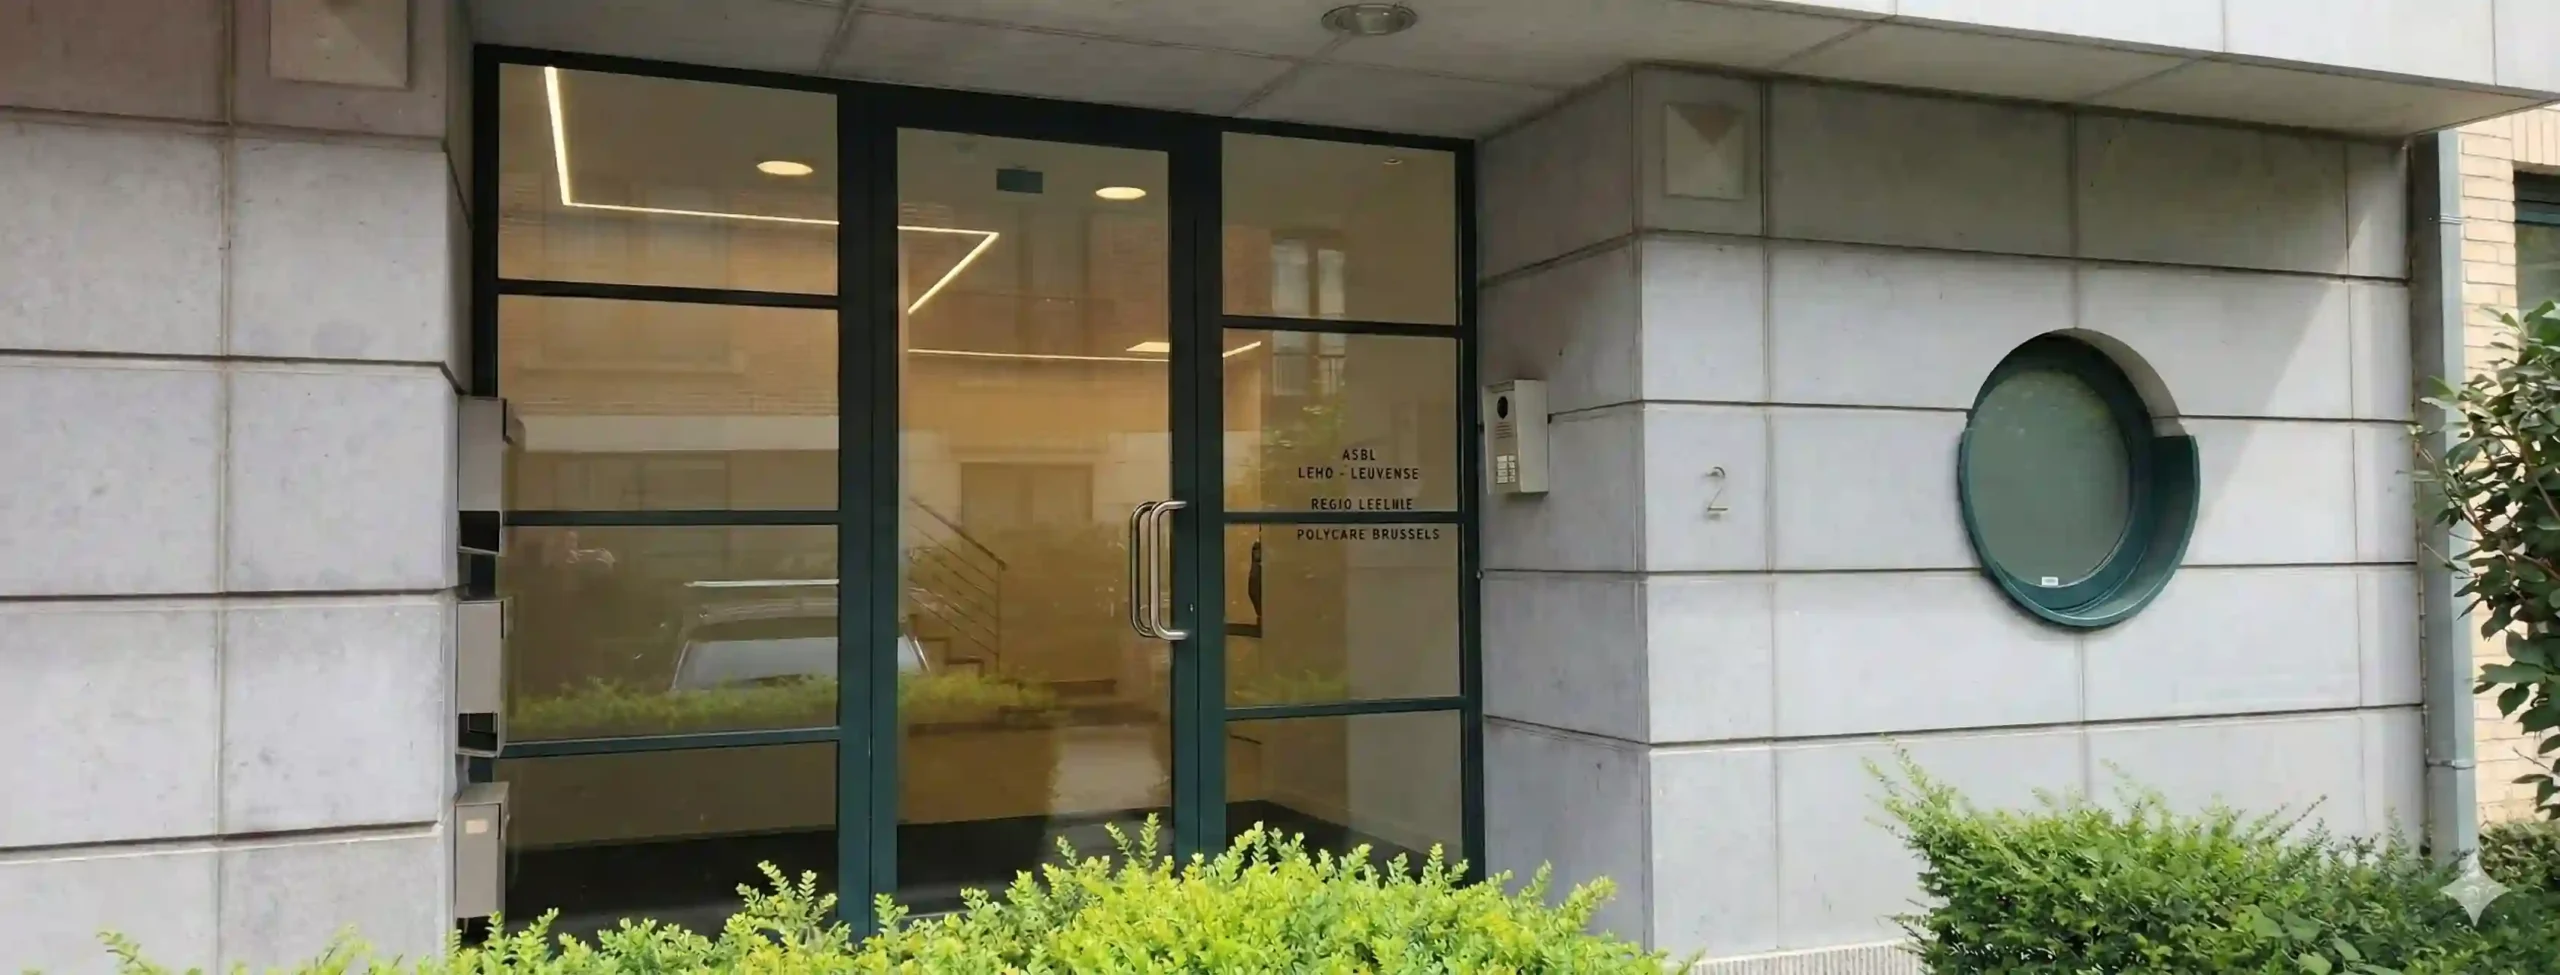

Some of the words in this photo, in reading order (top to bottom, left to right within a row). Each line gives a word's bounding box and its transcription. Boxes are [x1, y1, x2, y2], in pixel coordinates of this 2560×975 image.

[1342, 449, 1376, 461] ASBL
[1298, 467, 1333, 479] LEHO
[1351, 468, 1420, 480] LEUVENSE
[1705, 466, 1728, 513] 2
[1311, 498, 1352, 510] REGIO
[1297, 528, 1366, 540] POLYCARE
[1372, 528, 1440, 540] BRUSSELS
